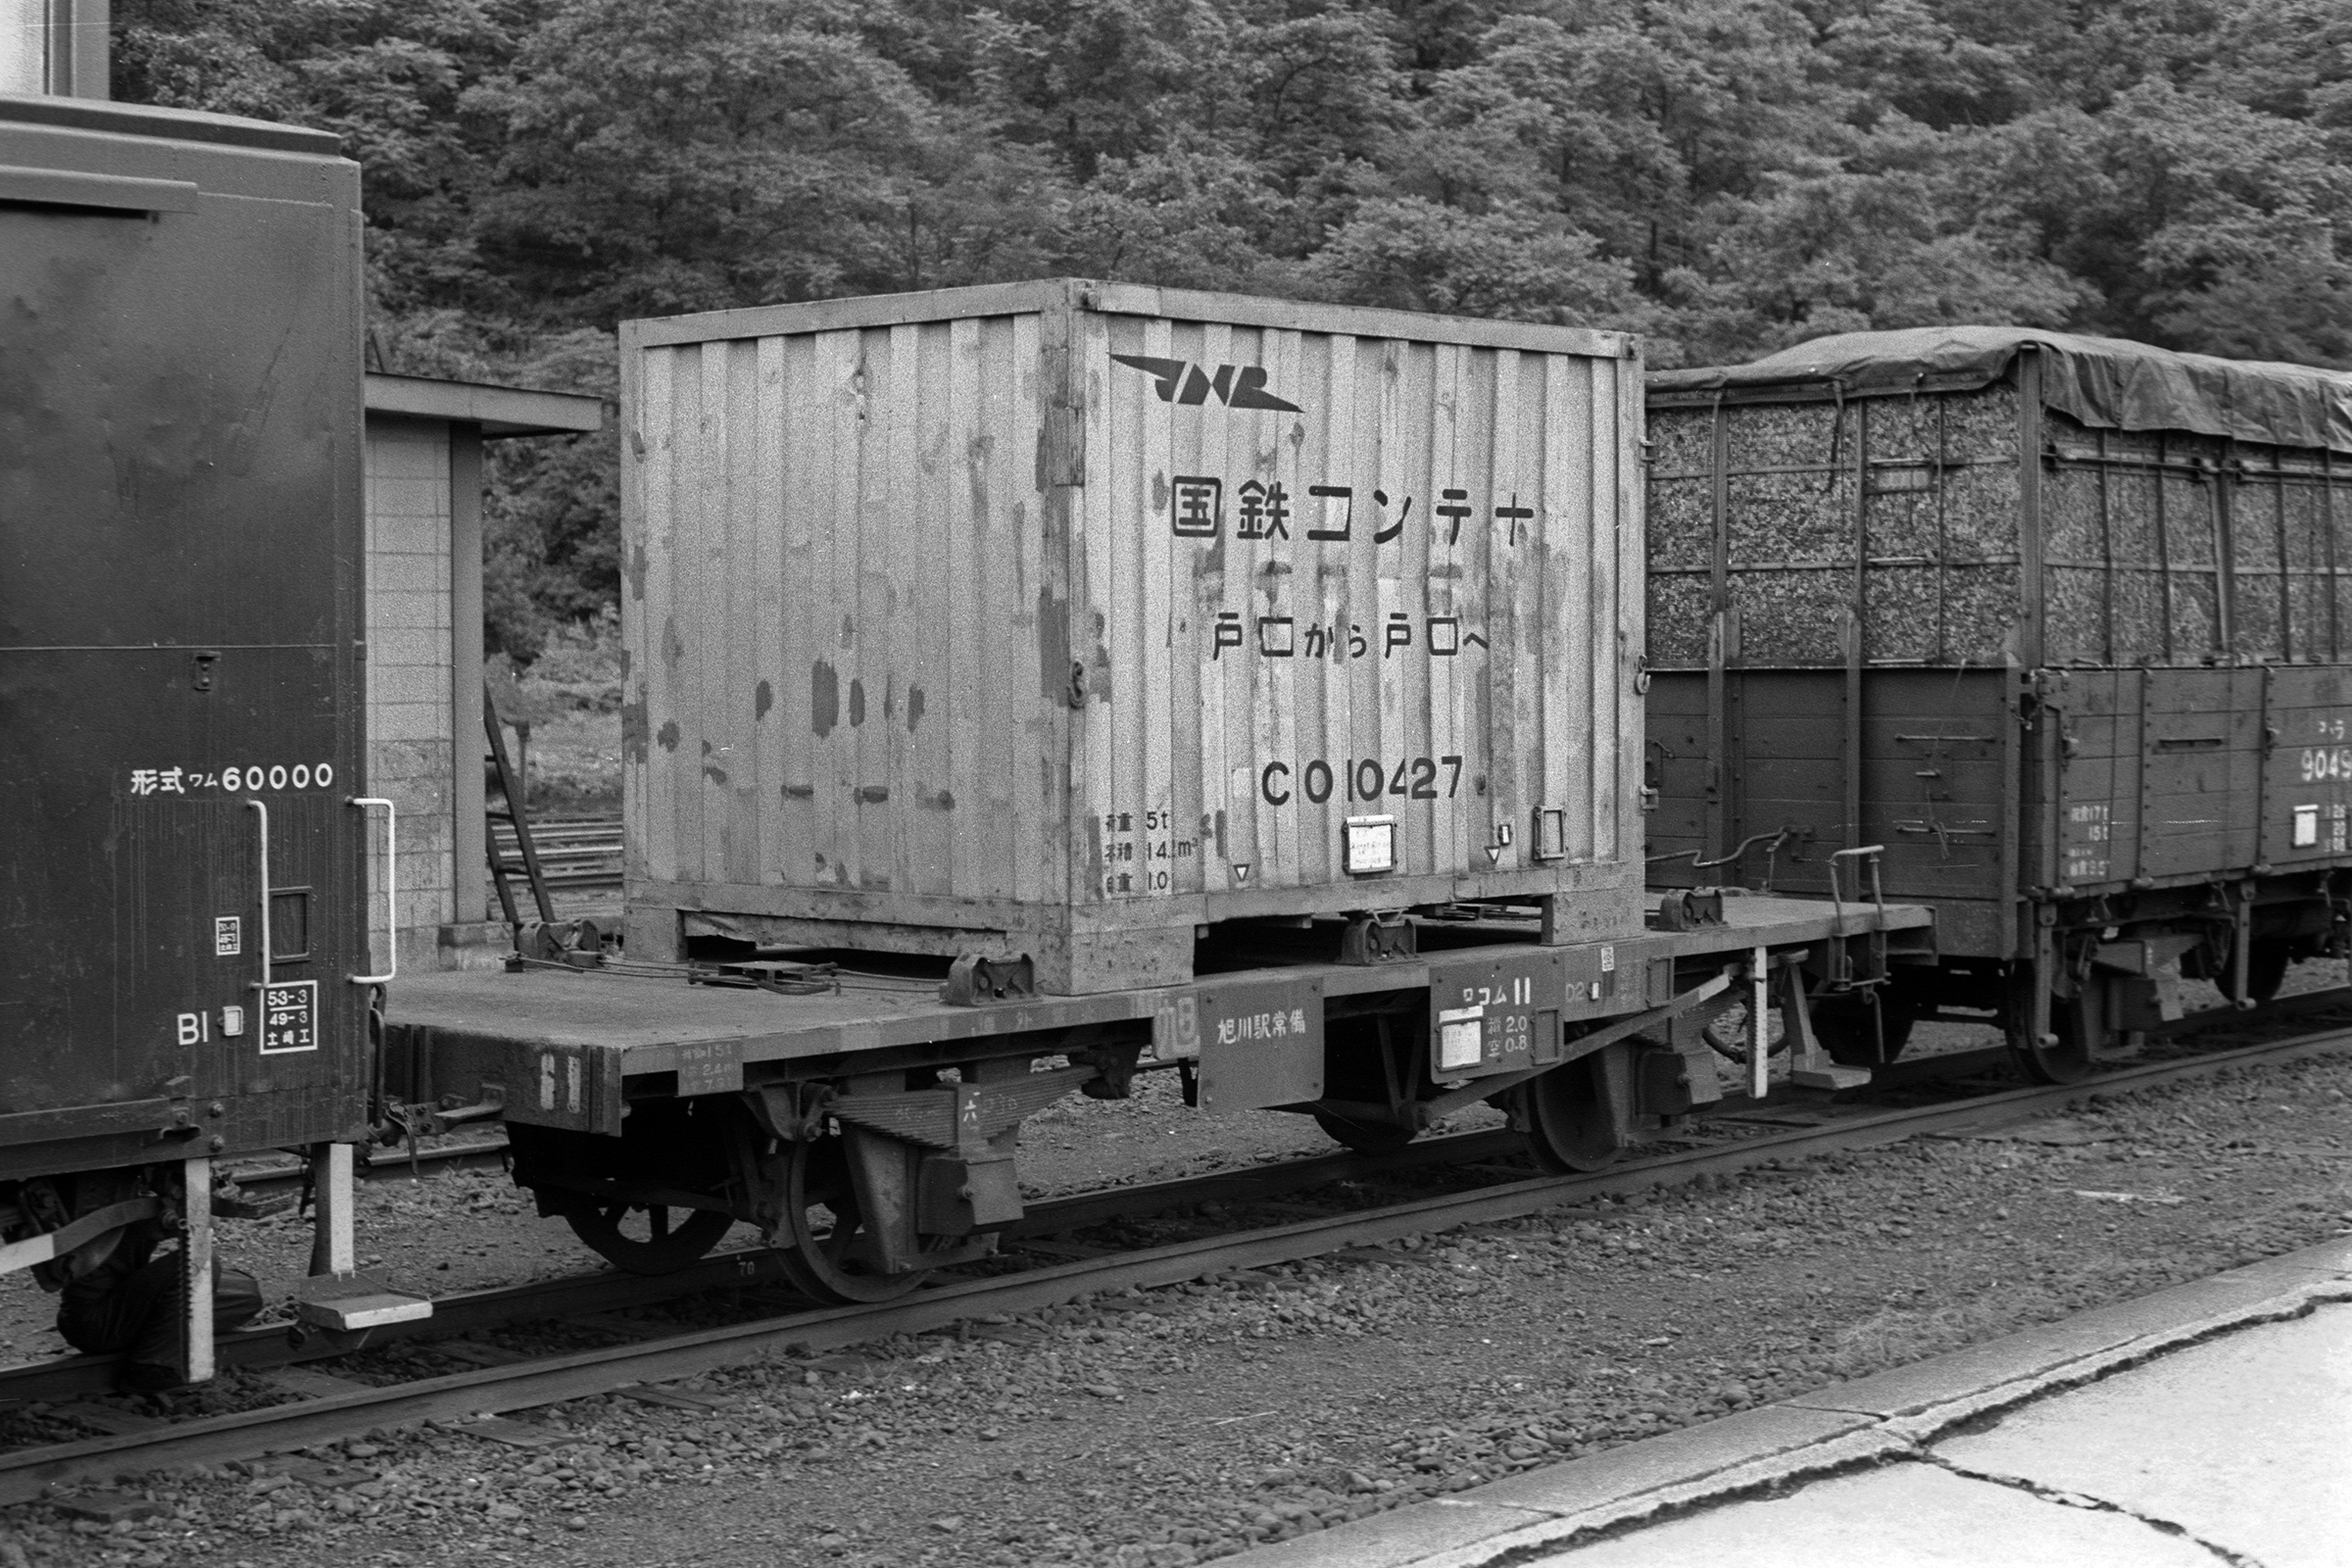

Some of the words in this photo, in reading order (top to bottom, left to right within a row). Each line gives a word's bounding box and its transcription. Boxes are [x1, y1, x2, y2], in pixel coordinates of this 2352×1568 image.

[1105, 352, 1305, 413] JNR
[1172, 475, 1534, 546] 国鉄コンテナ
[1213, 612, 1489, 661] 戸口から戸口へ
[130, 762, 333, 795] 形式ワム60000
[267, 989, 308, 1006] 53-3
[269, 1010, 309, 1026] 49-3
[1217, 1007, 1306, 1045] 旭川駅常備
[1505, 1015, 1527, 1033] 2.0
[1505, 1034, 1527, 1054] 0.8
